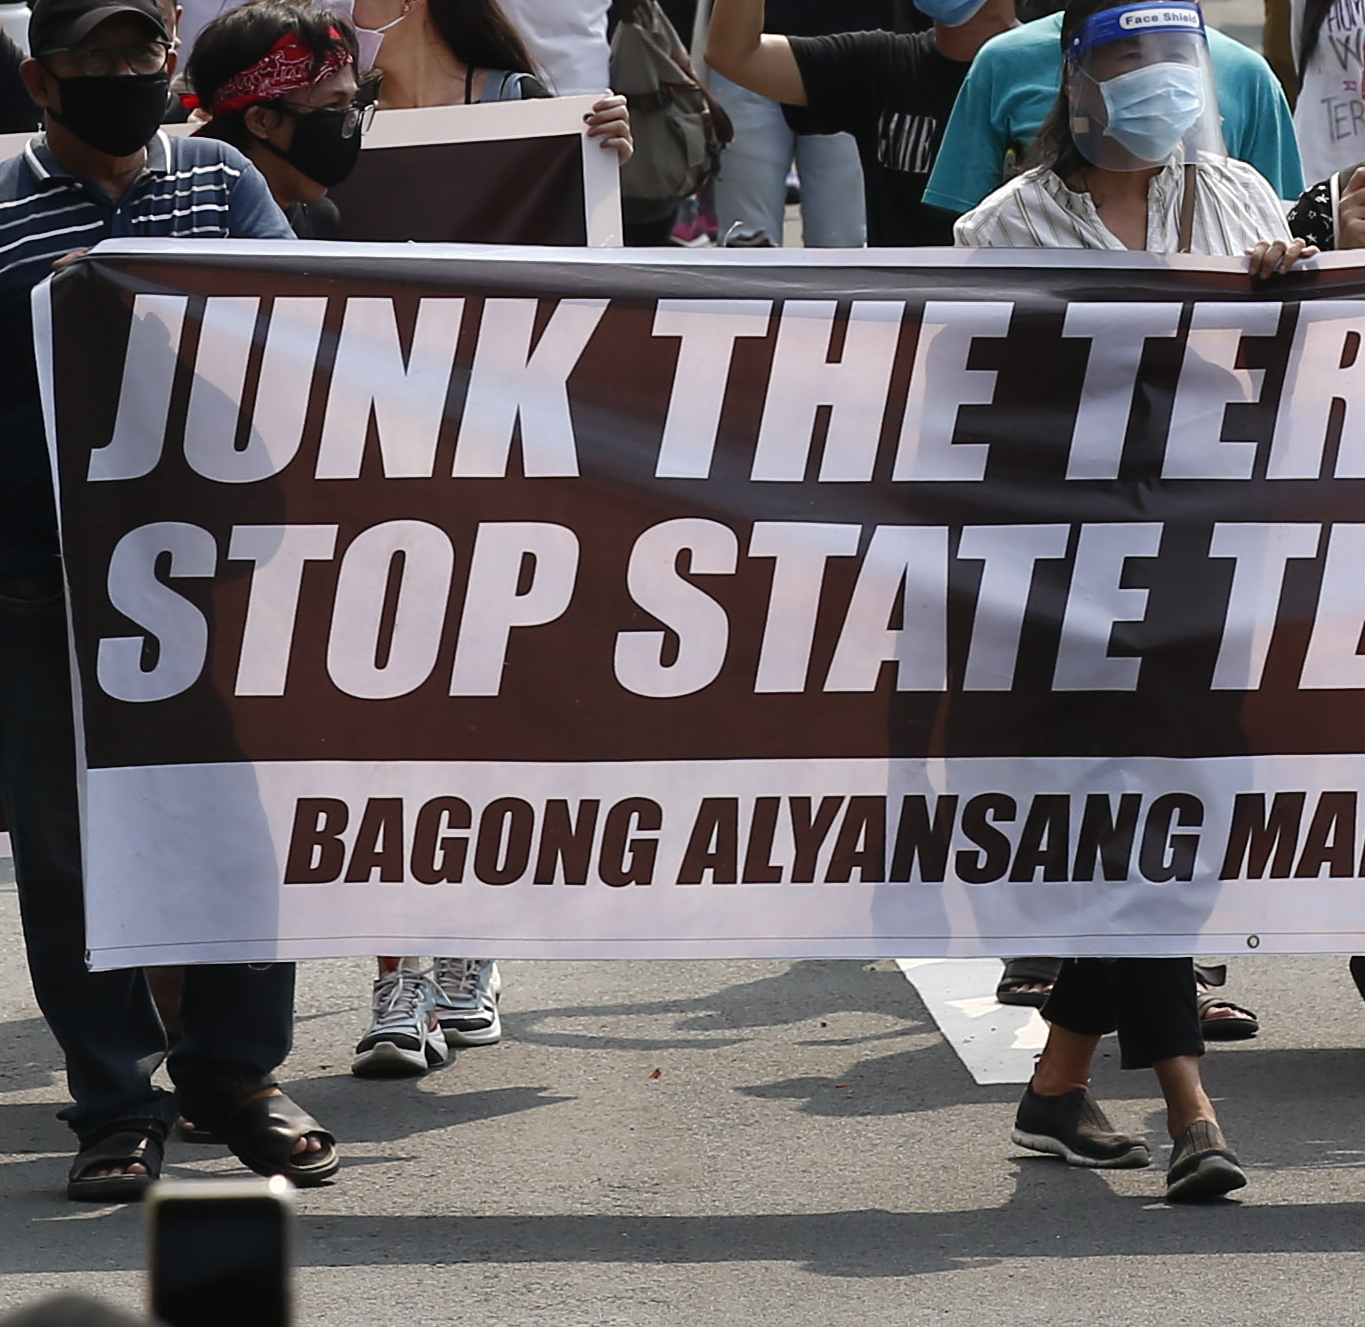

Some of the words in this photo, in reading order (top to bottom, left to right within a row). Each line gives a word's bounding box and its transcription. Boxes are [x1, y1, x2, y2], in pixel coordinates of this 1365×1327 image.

[1125, 12, 1159, 26] Face
[1162, 9, 1200, 25] Shield
[88, 293, 612, 483] JUNK
[651, 298, 1015, 484] THE
[97, 519, 580, 703] STOP
[615, 516, 1165, 699] STATE
[283, 794, 665, 889] BAGONG
[677, 791, 1205, 885] ALYANSANG
